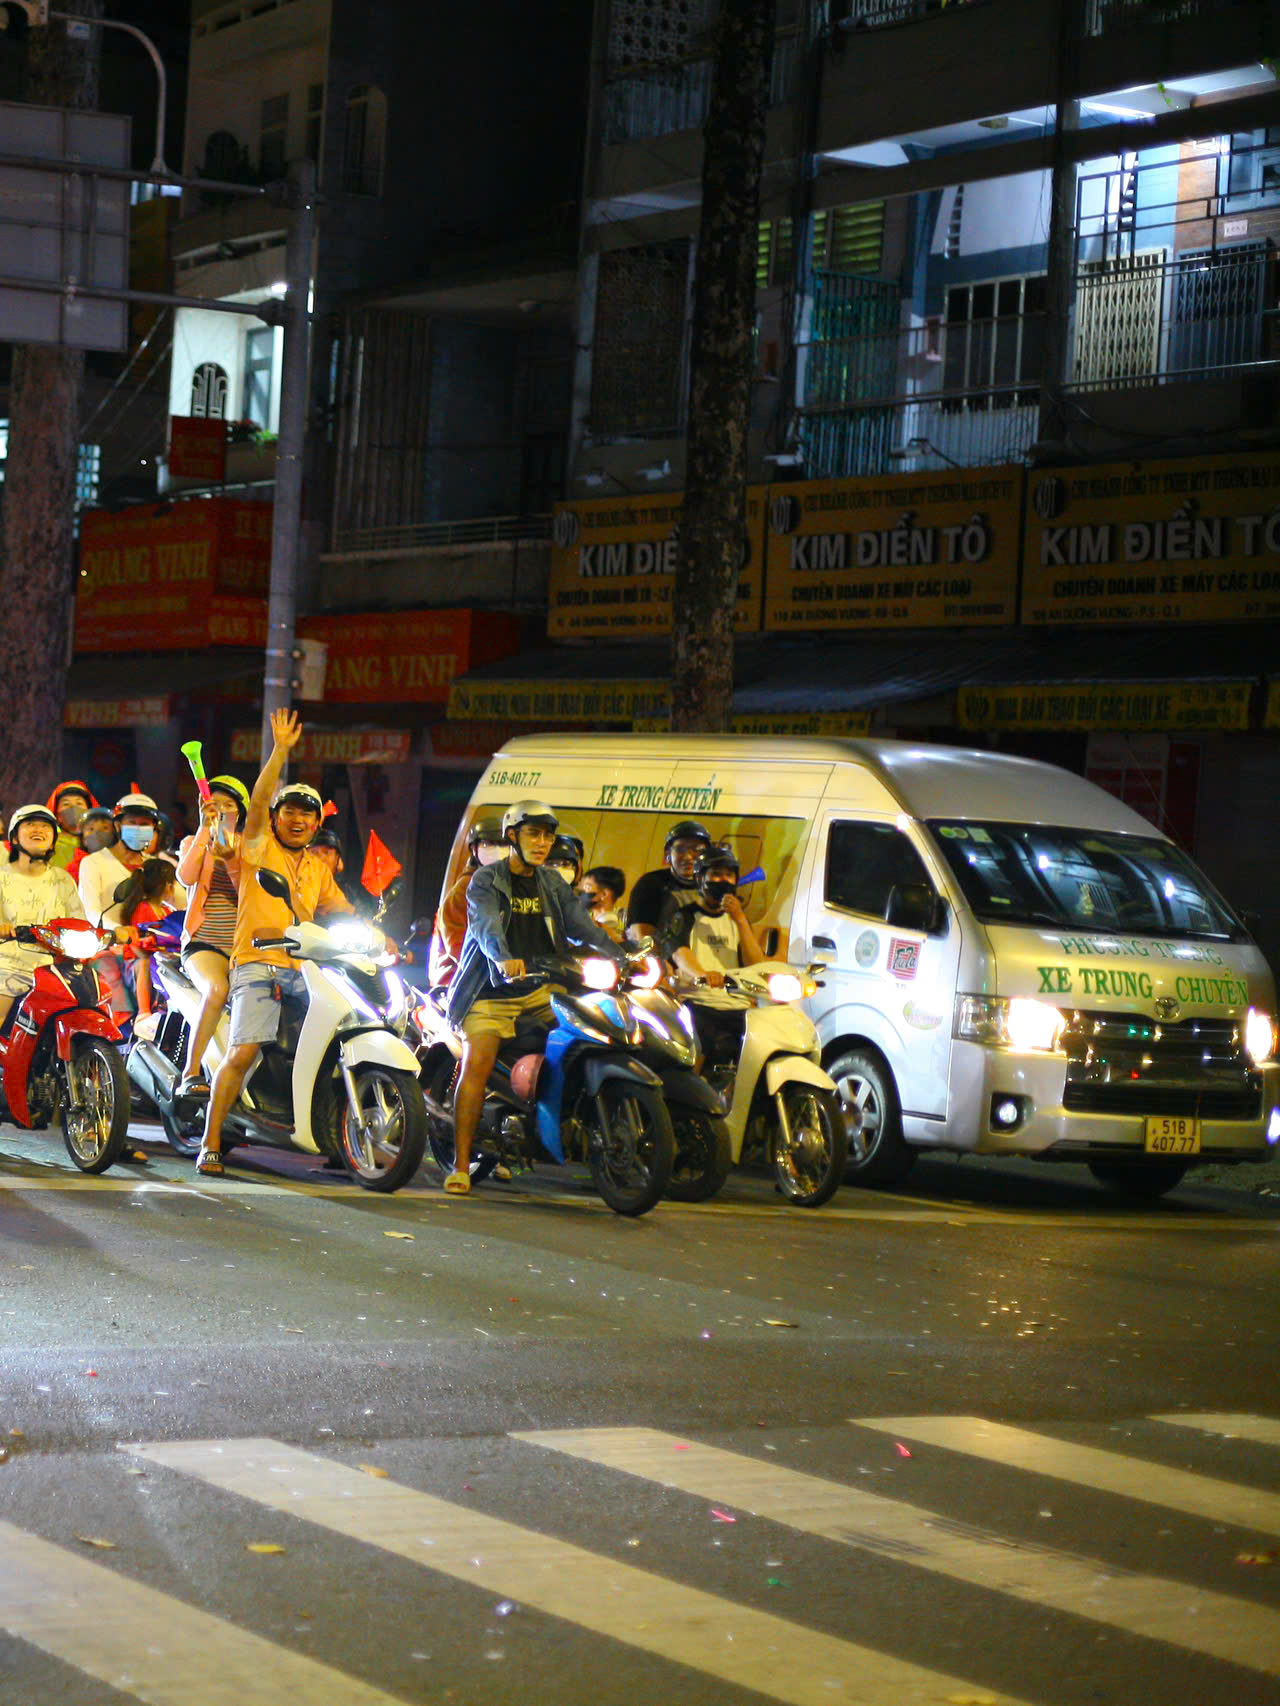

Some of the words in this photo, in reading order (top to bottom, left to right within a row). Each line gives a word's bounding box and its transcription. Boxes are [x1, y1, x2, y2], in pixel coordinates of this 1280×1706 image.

[790, 533, 847, 569] KIM
[942, 514, 987, 563] TÔ
[1040, 524, 1110, 566] KIM
[154, 540, 211, 582] VINH
[578, 543, 628, 577] KIM
[327, 652, 382, 689] ANG
[388, 652, 459, 688] VINH
[231, 734, 305, 761] QUG
[312, 732, 363, 761] VINH
[596, 785, 614, 807] XE
[618, 785, 666, 809] TRUNG
[1037, 966, 1073, 994] XE
[1078, 967, 1154, 999] TRUNG
[1175, 967, 1249, 1006] CHUYỂN
[1151, 1136, 1195, 1152] 407.77
[1162, 1119, 1187, 1136] 51B
